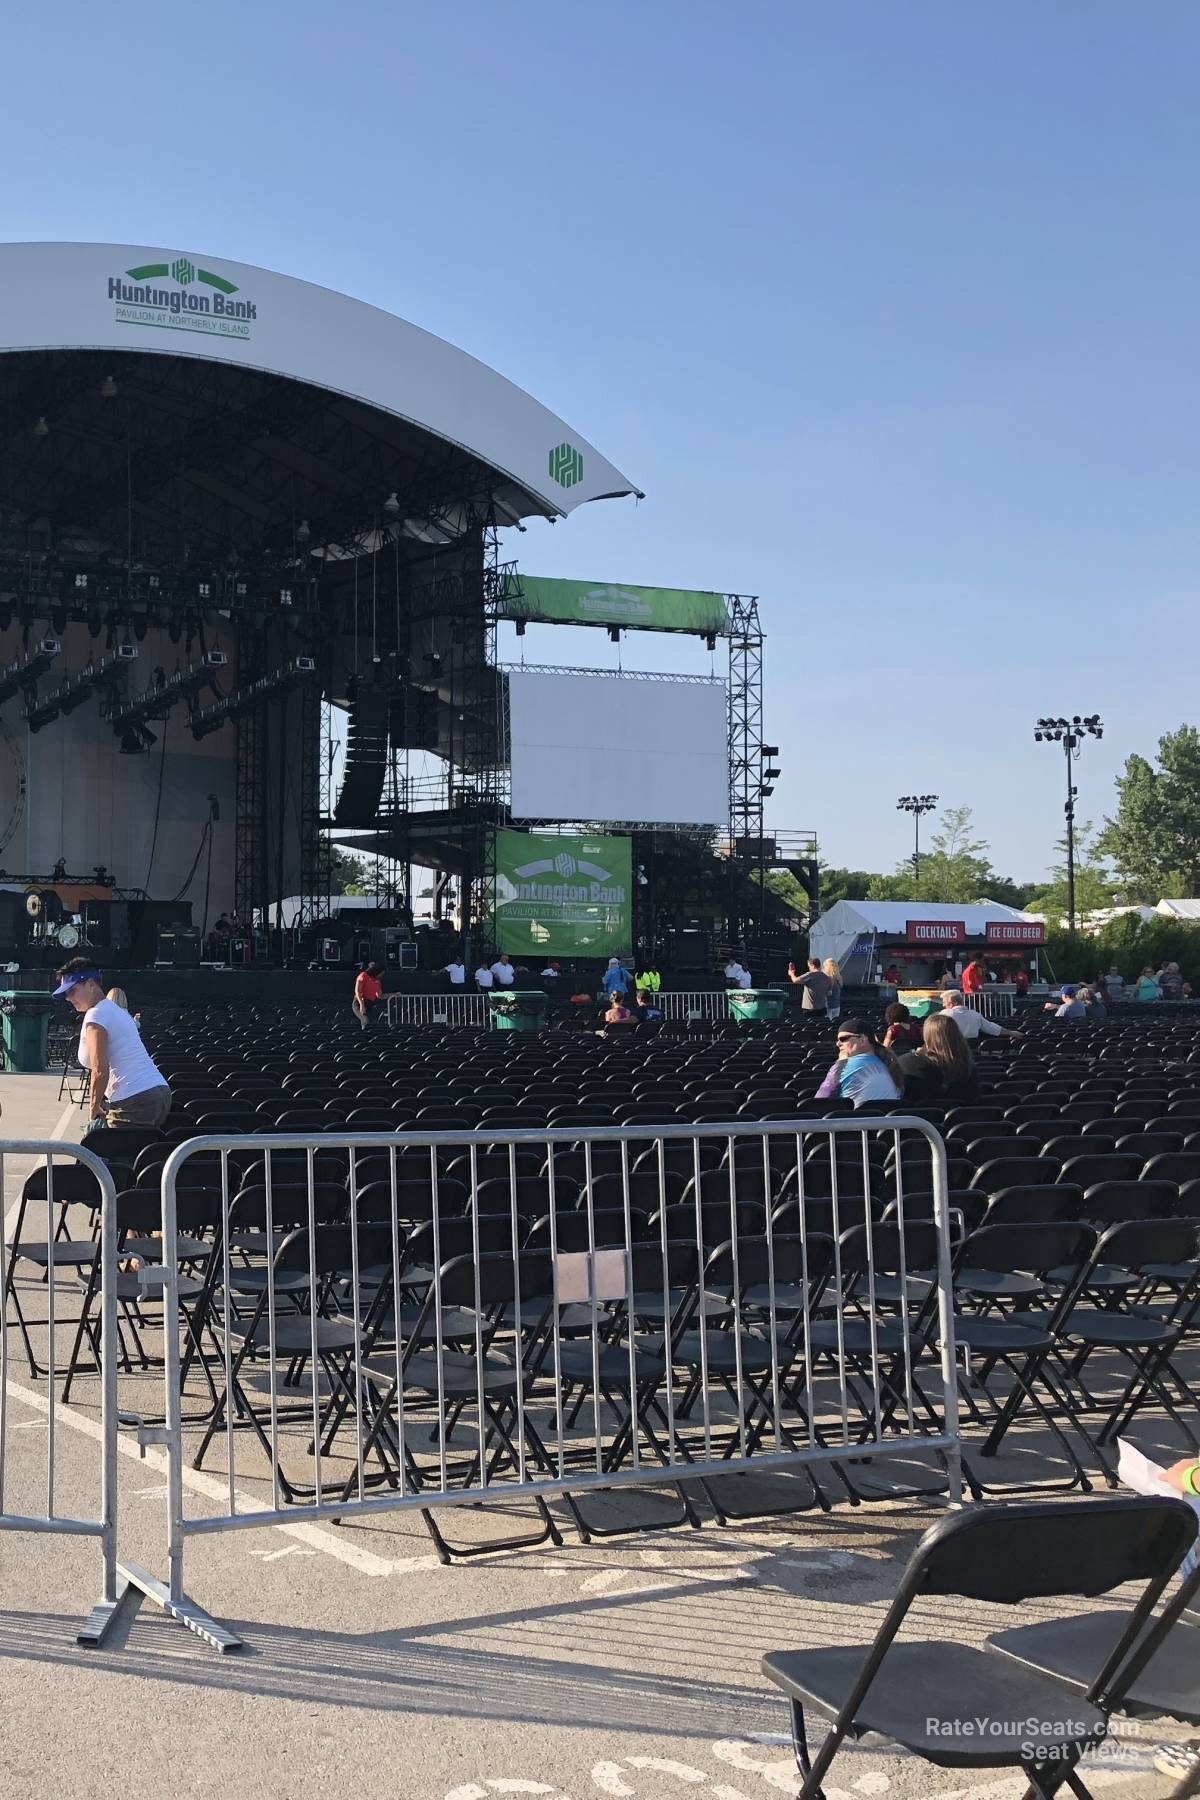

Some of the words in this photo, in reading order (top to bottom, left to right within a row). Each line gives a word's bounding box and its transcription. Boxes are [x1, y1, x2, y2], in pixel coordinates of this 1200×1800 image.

[108, 277, 210, 314] Huntington
[213, 293, 257, 319] Bank
[116, 307, 155, 321] PAVILION
[157, 313, 168, 323] AT
[168, 314, 218, 331] NORTHERLY
[219, 322, 250, 335] ISLAND
[590, 881, 625, 902] Bank
[502, 906, 539, 917] PAVILION
[915, 925, 958, 939] COCKTAILS
[989, 926, 1001, 939] ICE
[1002, 927, 1021, 939] COLD
[1022, 927, 1041, 939] BEER
